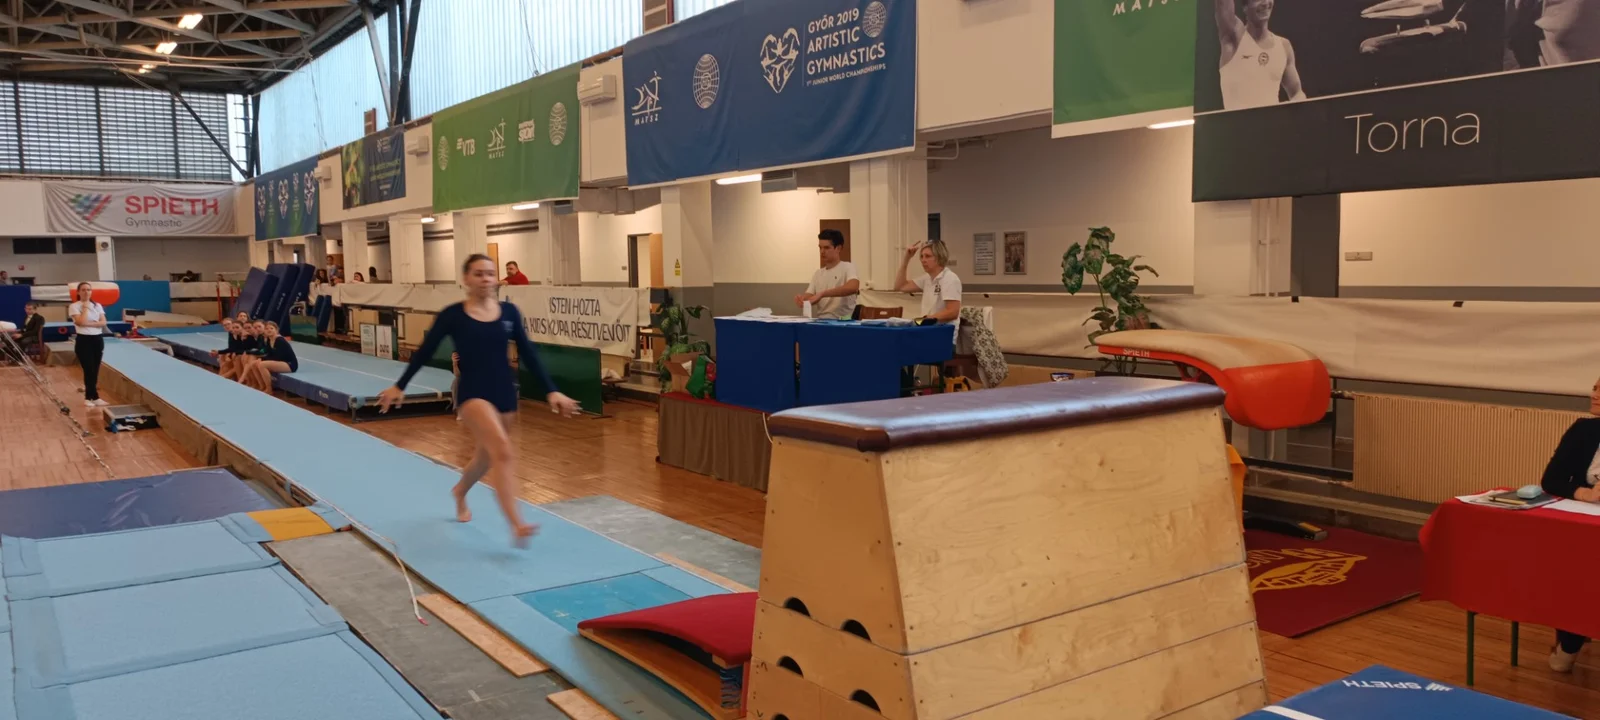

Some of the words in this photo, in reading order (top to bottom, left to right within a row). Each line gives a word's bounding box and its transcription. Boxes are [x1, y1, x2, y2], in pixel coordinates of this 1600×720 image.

[808, 14, 834, 34] GYŐR
[836, 7, 860, 26] 2019
[807, 26, 860, 54] ARTISTIC
[806, 42, 886, 75] GYMNASTICS
[812, 75, 829, 86] JUNIOR
[829, 72, 846, 82] WORLD
[845, 63, 887, 78] CHAMPIONSHIPS
[1344, 112, 1480, 154] Torna
[124, 195, 219, 216] SPIETH
[124, 216, 183, 228] Gymnastic
[549, 297, 571, 315] ISTEN
[572, 298, 601, 317] HOZTA
[1122, 347, 1150, 358] SPIETH
[1341, 679, 1422, 690] SPIETH
